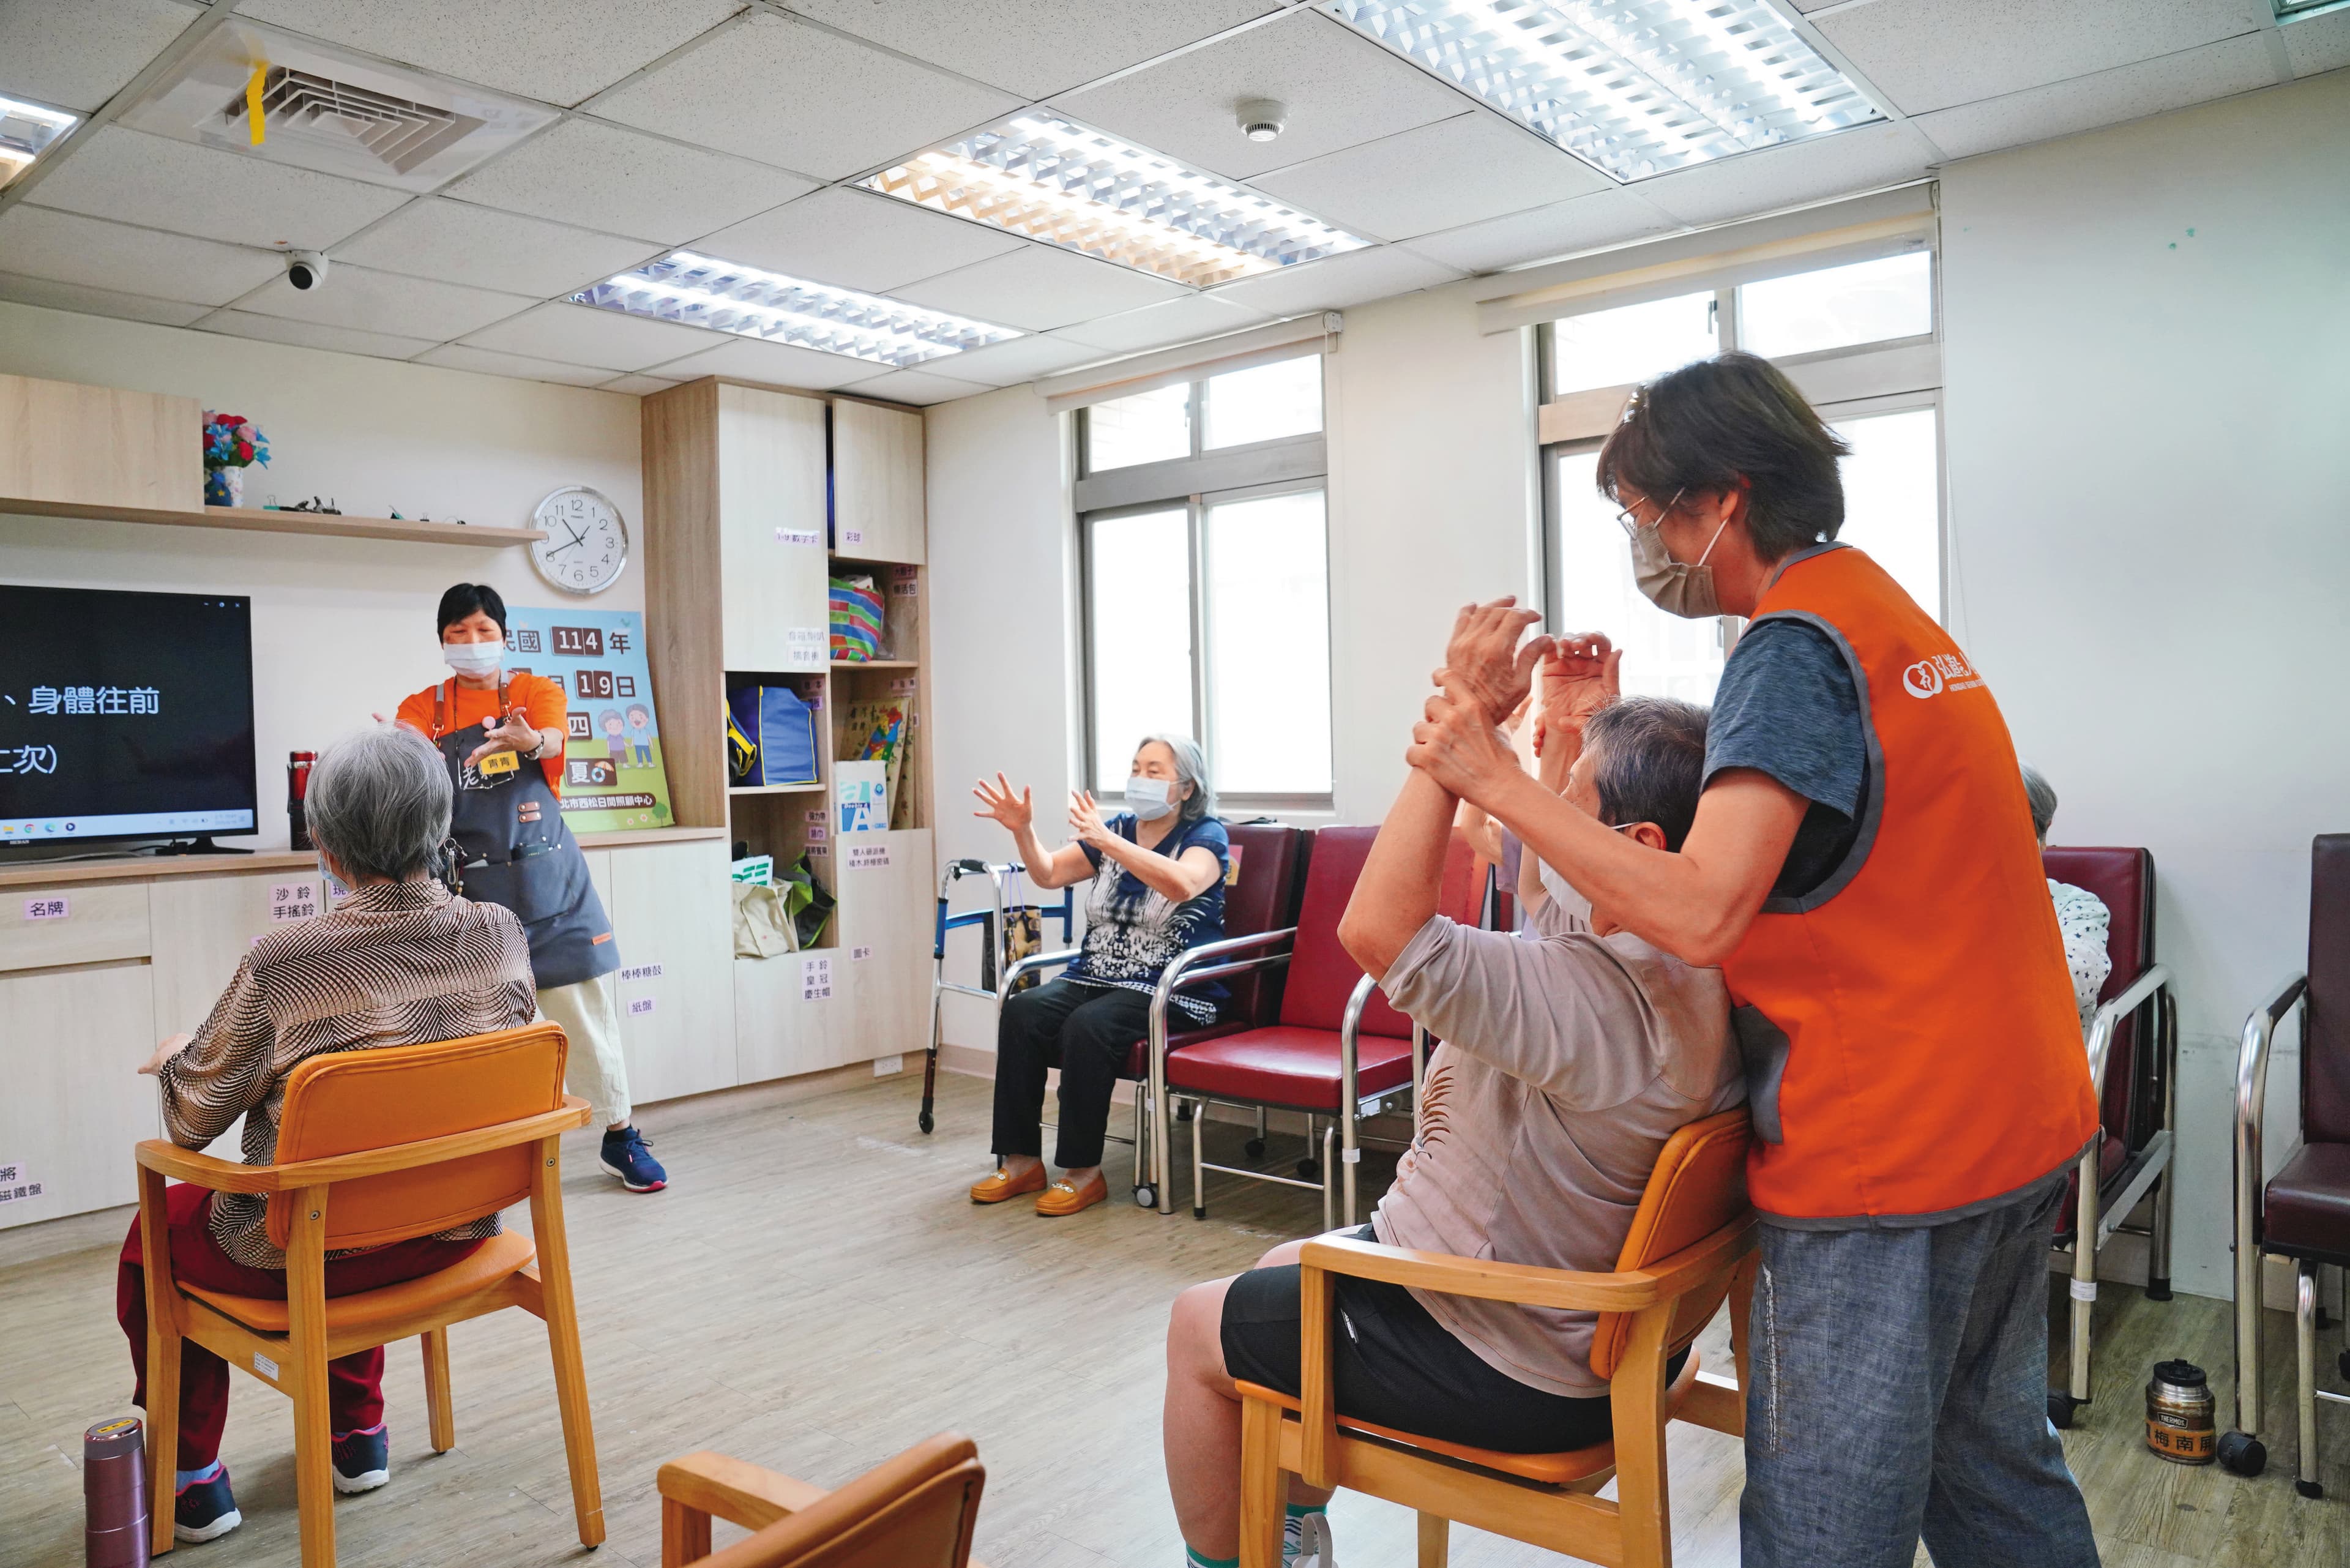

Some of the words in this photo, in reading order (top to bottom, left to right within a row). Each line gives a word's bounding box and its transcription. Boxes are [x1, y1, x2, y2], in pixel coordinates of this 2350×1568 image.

[555, 504, 564, 516] 11
[572, 499, 583, 512] 12
[592, 507, 595, 518] 1
[545, 515, 557, 528] 10
[599, 519, 608, 531] 2
[606, 537, 614, 549] 3
[546, 551, 555, 562] 8
[601, 553, 610, 565] 4
[558, 564, 567, 576] 7
[573, 570, 583, 581] 6
[590, 566, 599, 577] 5
[559, 630, 598, 650] 114
[609, 632, 631, 655] 年
[581, 674, 611, 695] 19
[616, 676, 636, 697] 日
[569, 716, 589, 736] 四
[569, 761, 591, 783] 夏
[276, 886, 310, 901] 沙鈴
[30, 901, 64, 916] 名牌
[274, 904, 315, 919] 手搖鈴
[2160, 1414, 2185, 1426] THERMOS
